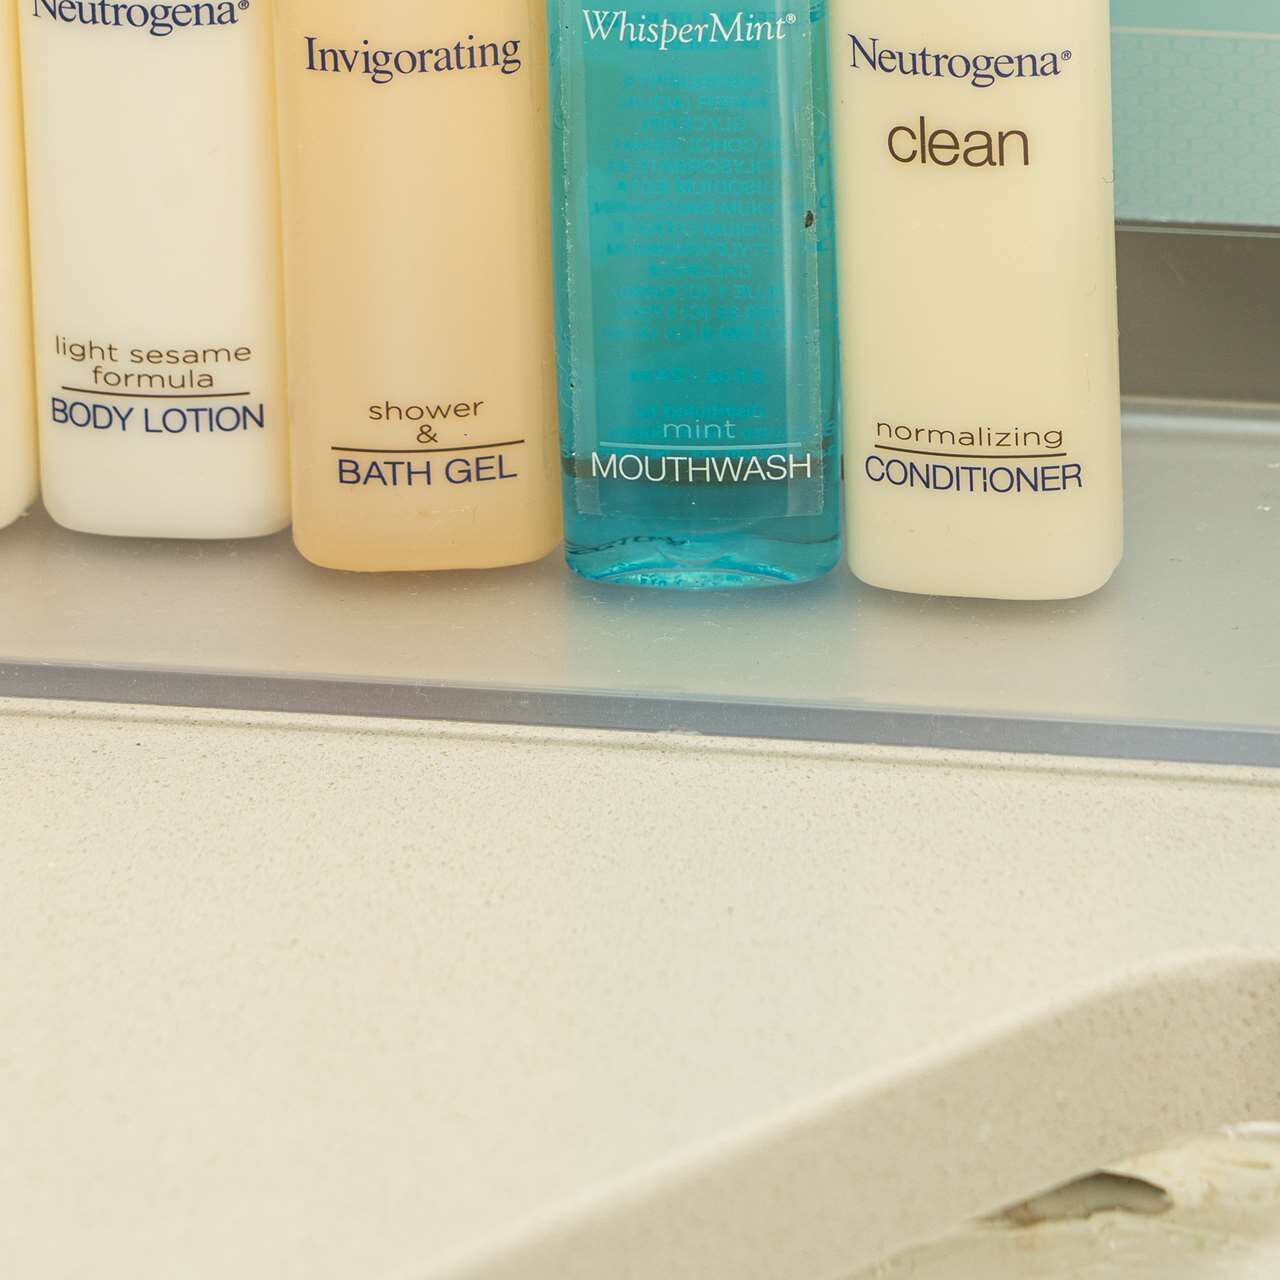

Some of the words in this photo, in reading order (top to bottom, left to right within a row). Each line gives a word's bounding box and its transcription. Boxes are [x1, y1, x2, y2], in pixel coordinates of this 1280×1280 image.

[304, 34, 521, 83] Invigorating
[887, 116, 1030, 166] clean
[55, 336, 117, 363] light
[130, 343, 253, 364] sesame
[93, 365, 214, 389] formula
[51, 397, 134, 431] BODY
[144, 404, 265, 433] LOTION
[369, 398, 484, 420] shower
[416, 424, 439, 444] &
[663, 419, 736, 439] mint
[876, 420, 1063, 448] normalizing
[337, 457, 431, 486] BATH
[445, 454, 517, 482] GEL
[591, 453, 812, 482] MOUTHWASH
[865, 455, 1083, 493] CONDITIONER
